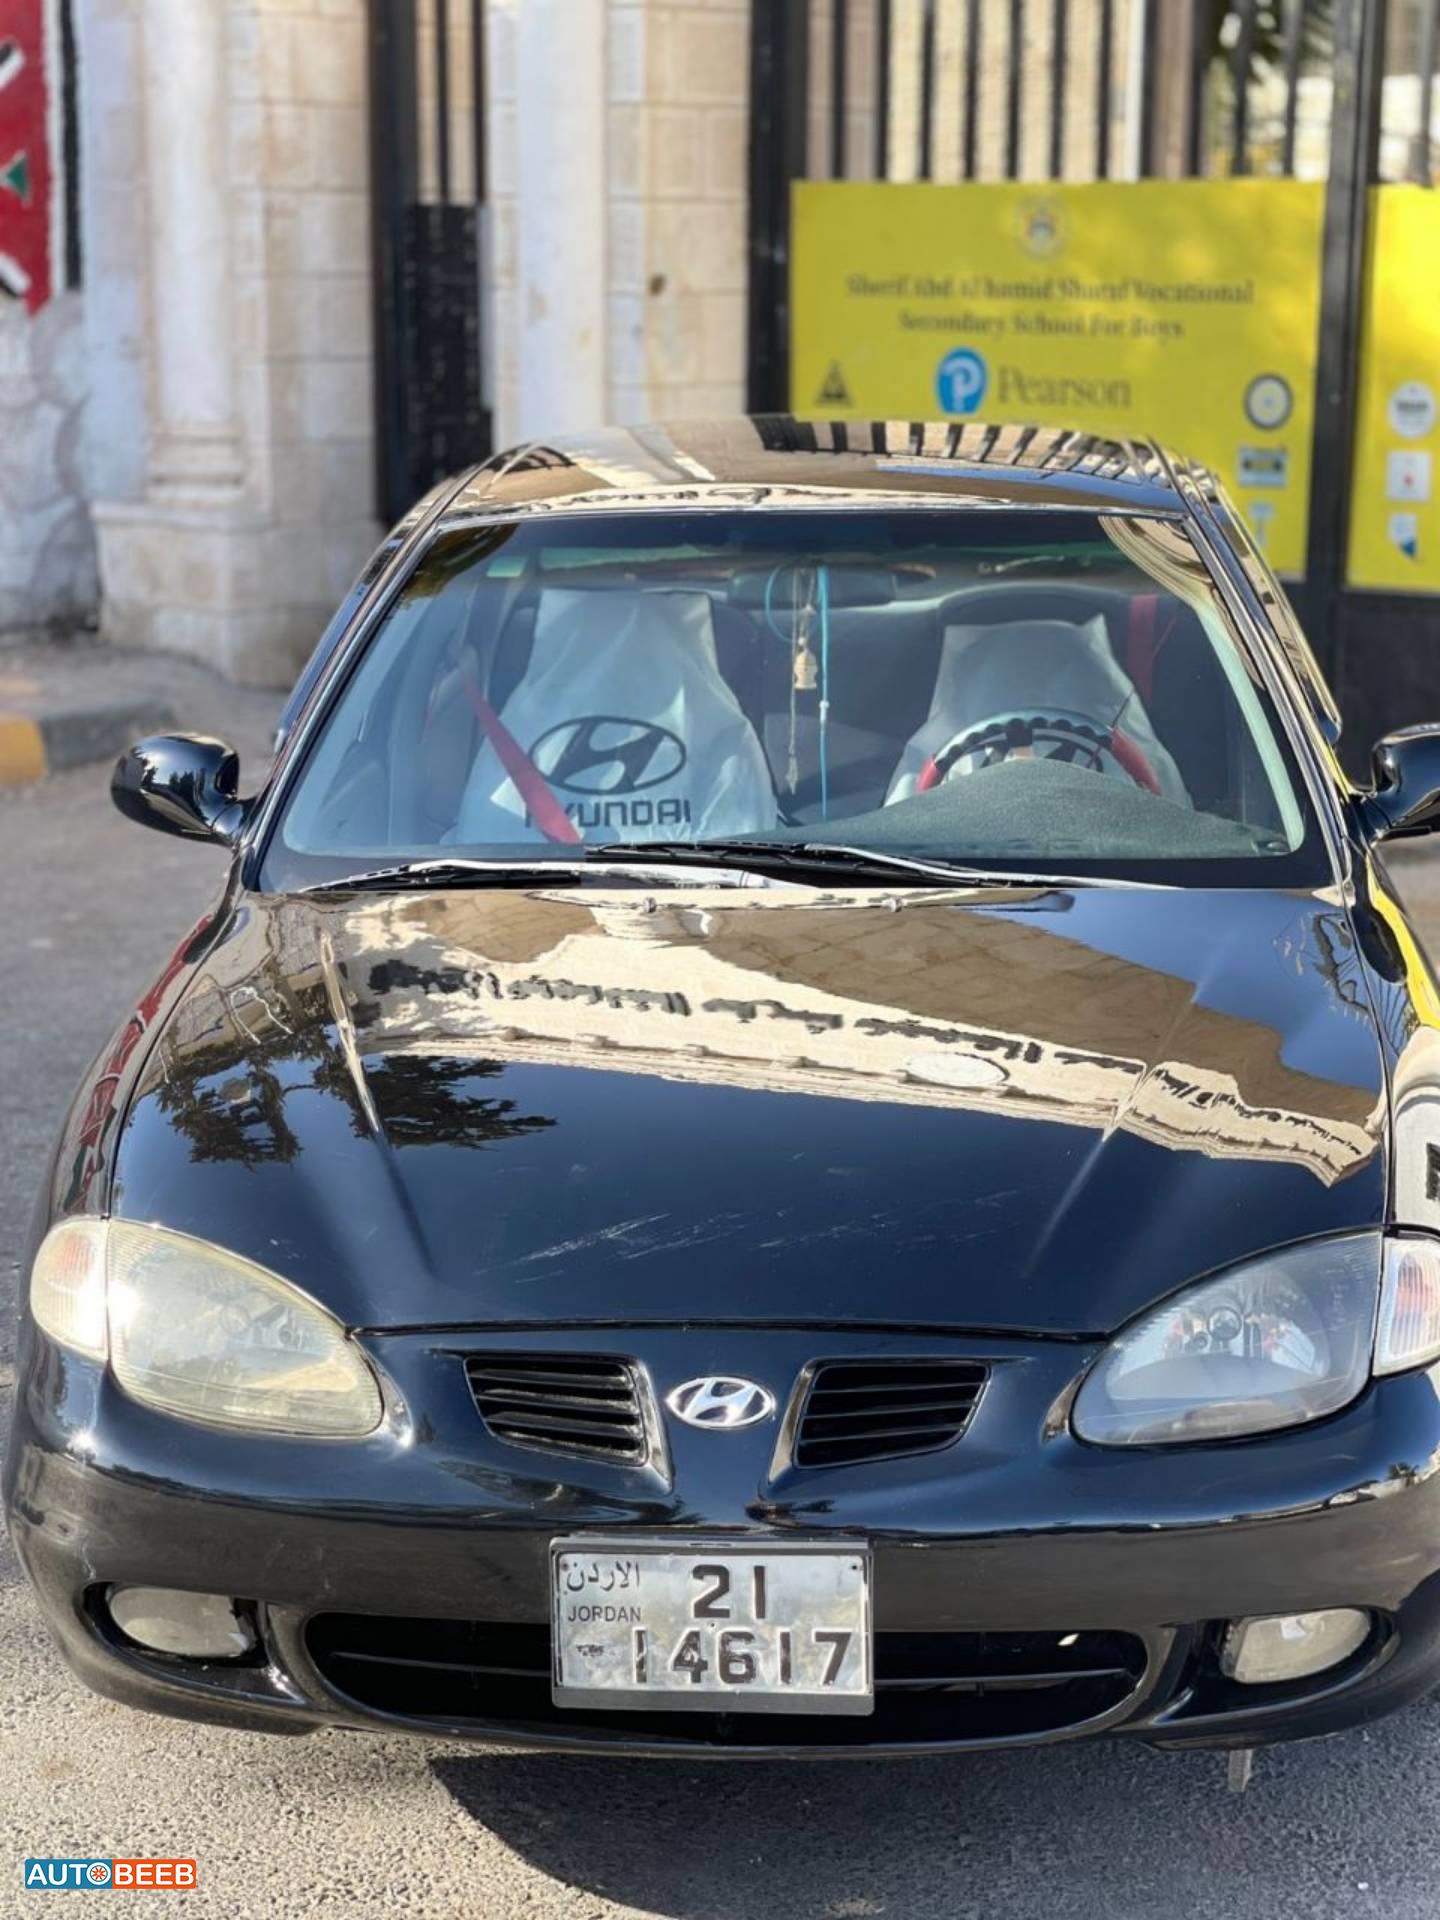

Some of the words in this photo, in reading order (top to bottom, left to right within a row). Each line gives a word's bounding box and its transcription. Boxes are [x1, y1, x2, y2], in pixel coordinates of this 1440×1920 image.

[1133, 279, 1254, 304] Vocational
[899, 310, 1005, 341] Secondary
[1013, 312, 1086, 336] School
[997, 367, 1132, 408] Pearson
[692, 1564, 767, 1619] 21
[567, 1605, 641, 1622] JORDAN
[633, 1629, 852, 1686] 14617
